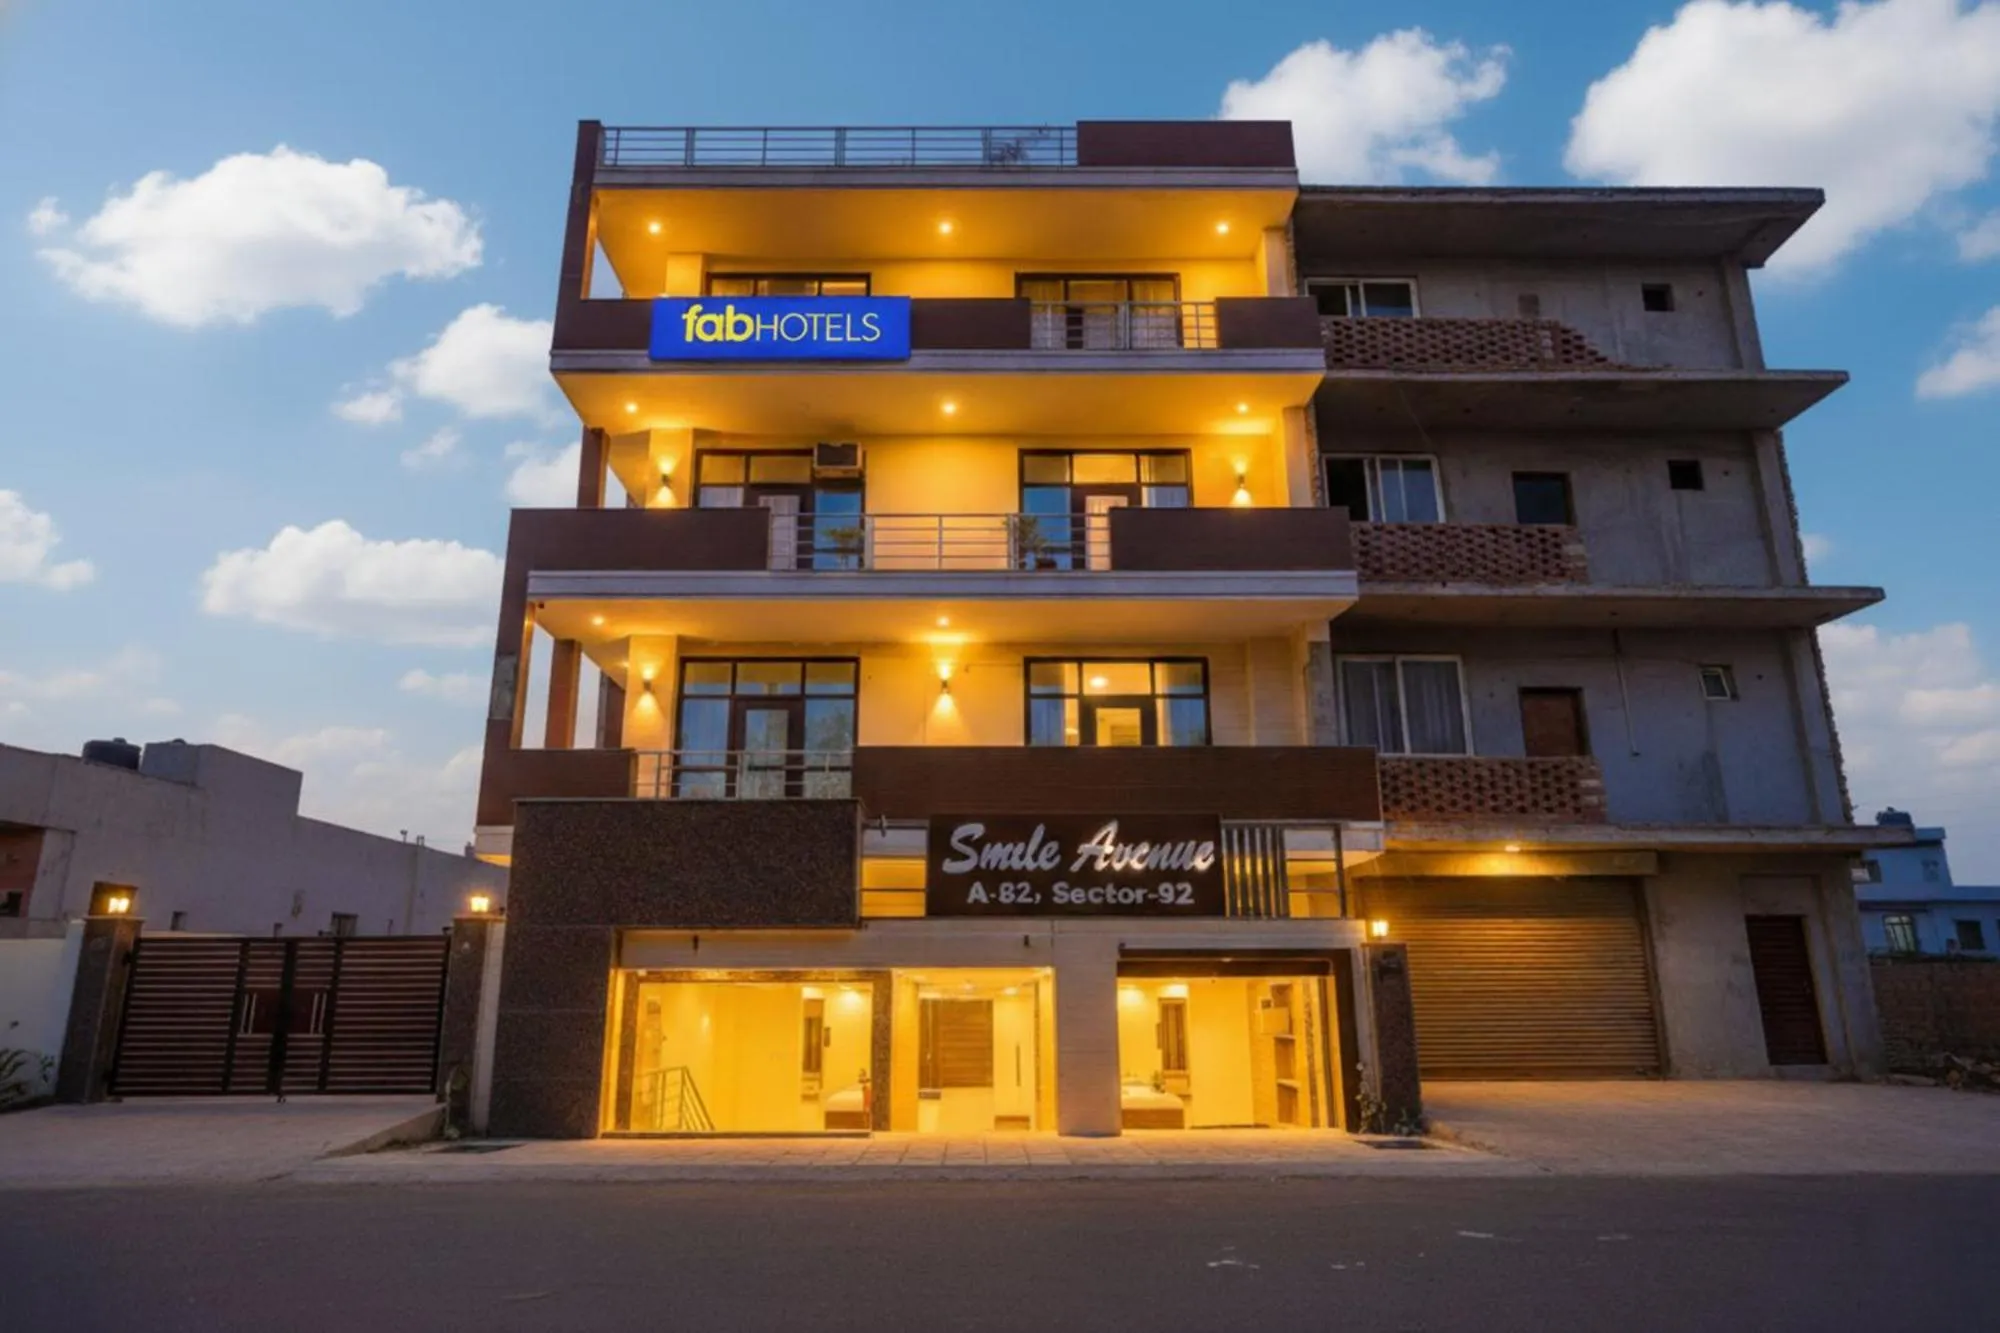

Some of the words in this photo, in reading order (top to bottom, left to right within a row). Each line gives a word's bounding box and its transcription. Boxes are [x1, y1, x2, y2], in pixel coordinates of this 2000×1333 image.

[682, 304, 881, 342] fabHOTELS
[1070, 820, 1215, 872] Avenue
[967, 881, 1041, 904] A-82,
[1052, 881, 1194, 904] Sector-92
